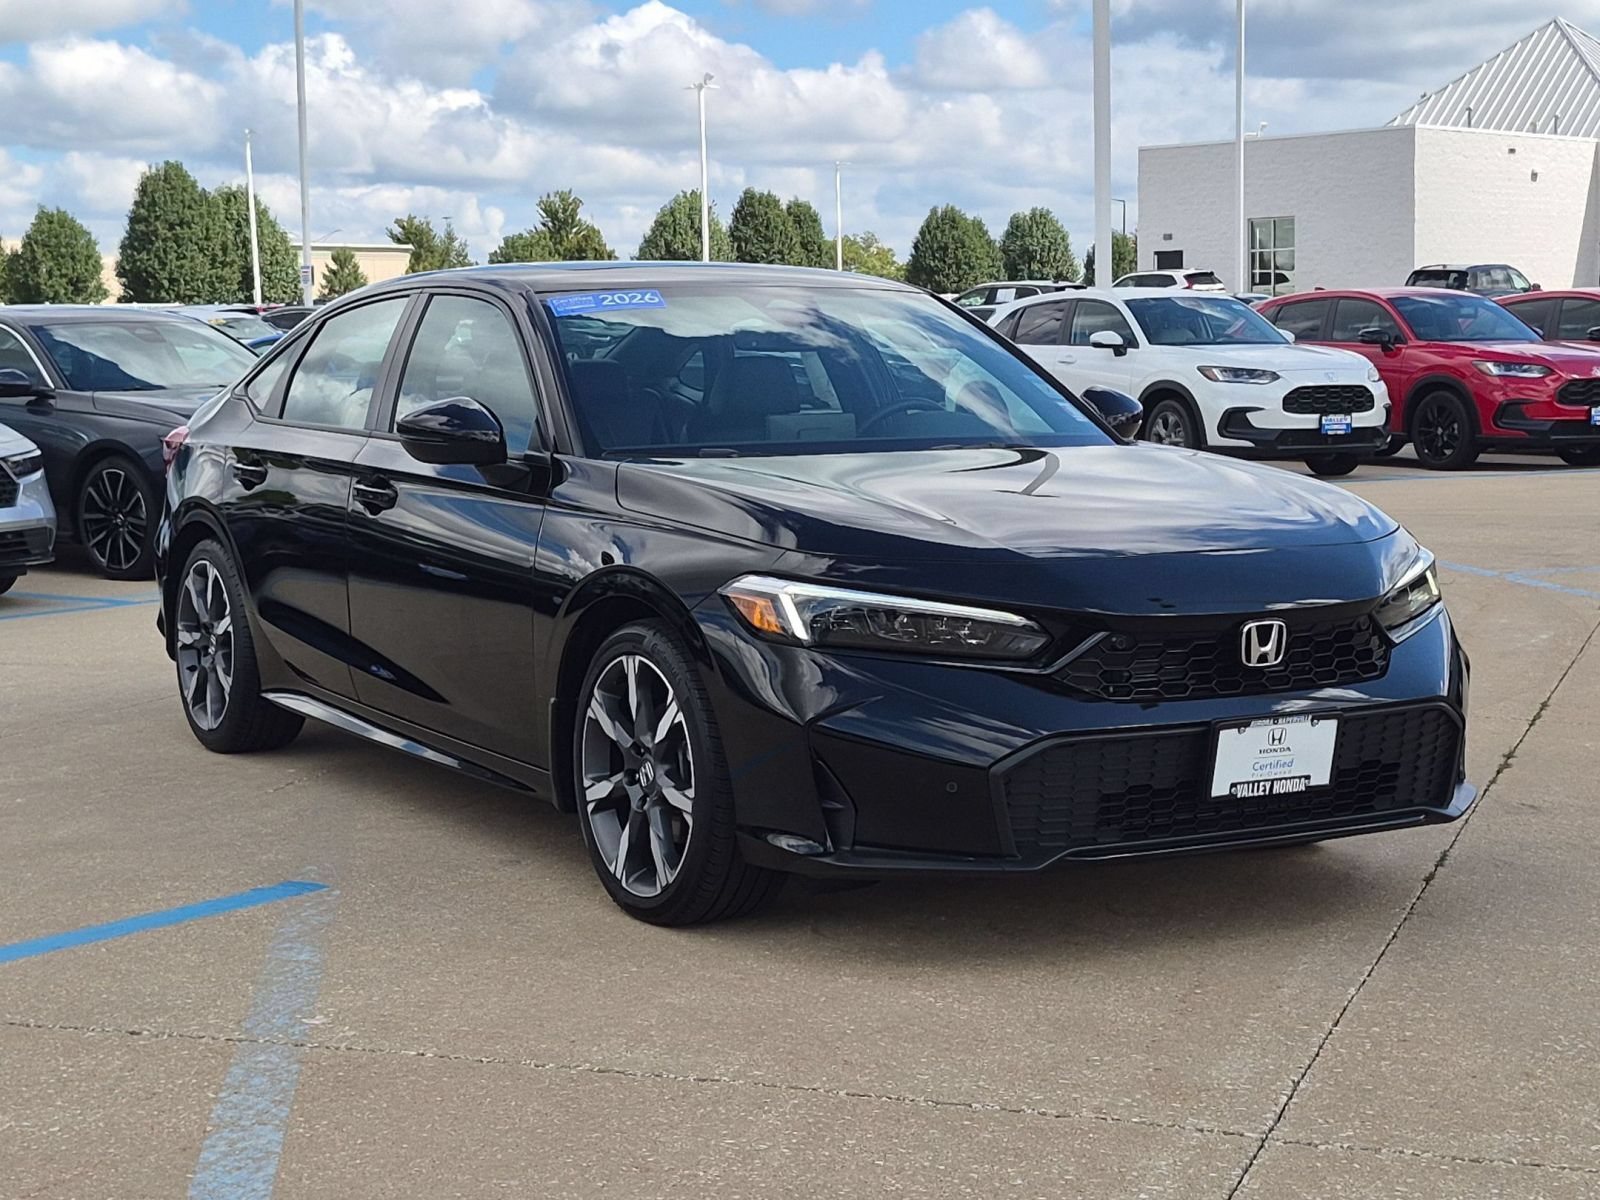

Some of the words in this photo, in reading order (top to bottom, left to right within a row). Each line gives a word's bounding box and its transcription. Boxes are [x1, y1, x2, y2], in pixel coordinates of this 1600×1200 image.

[598, 292, 660, 306] 2026
[1259, 746, 1292, 755] HONDA
[1252, 758, 1295, 772] Certified
[1236, 781, 1272, 799] VALLEY
[1272, 777, 1306, 795] HONDA
